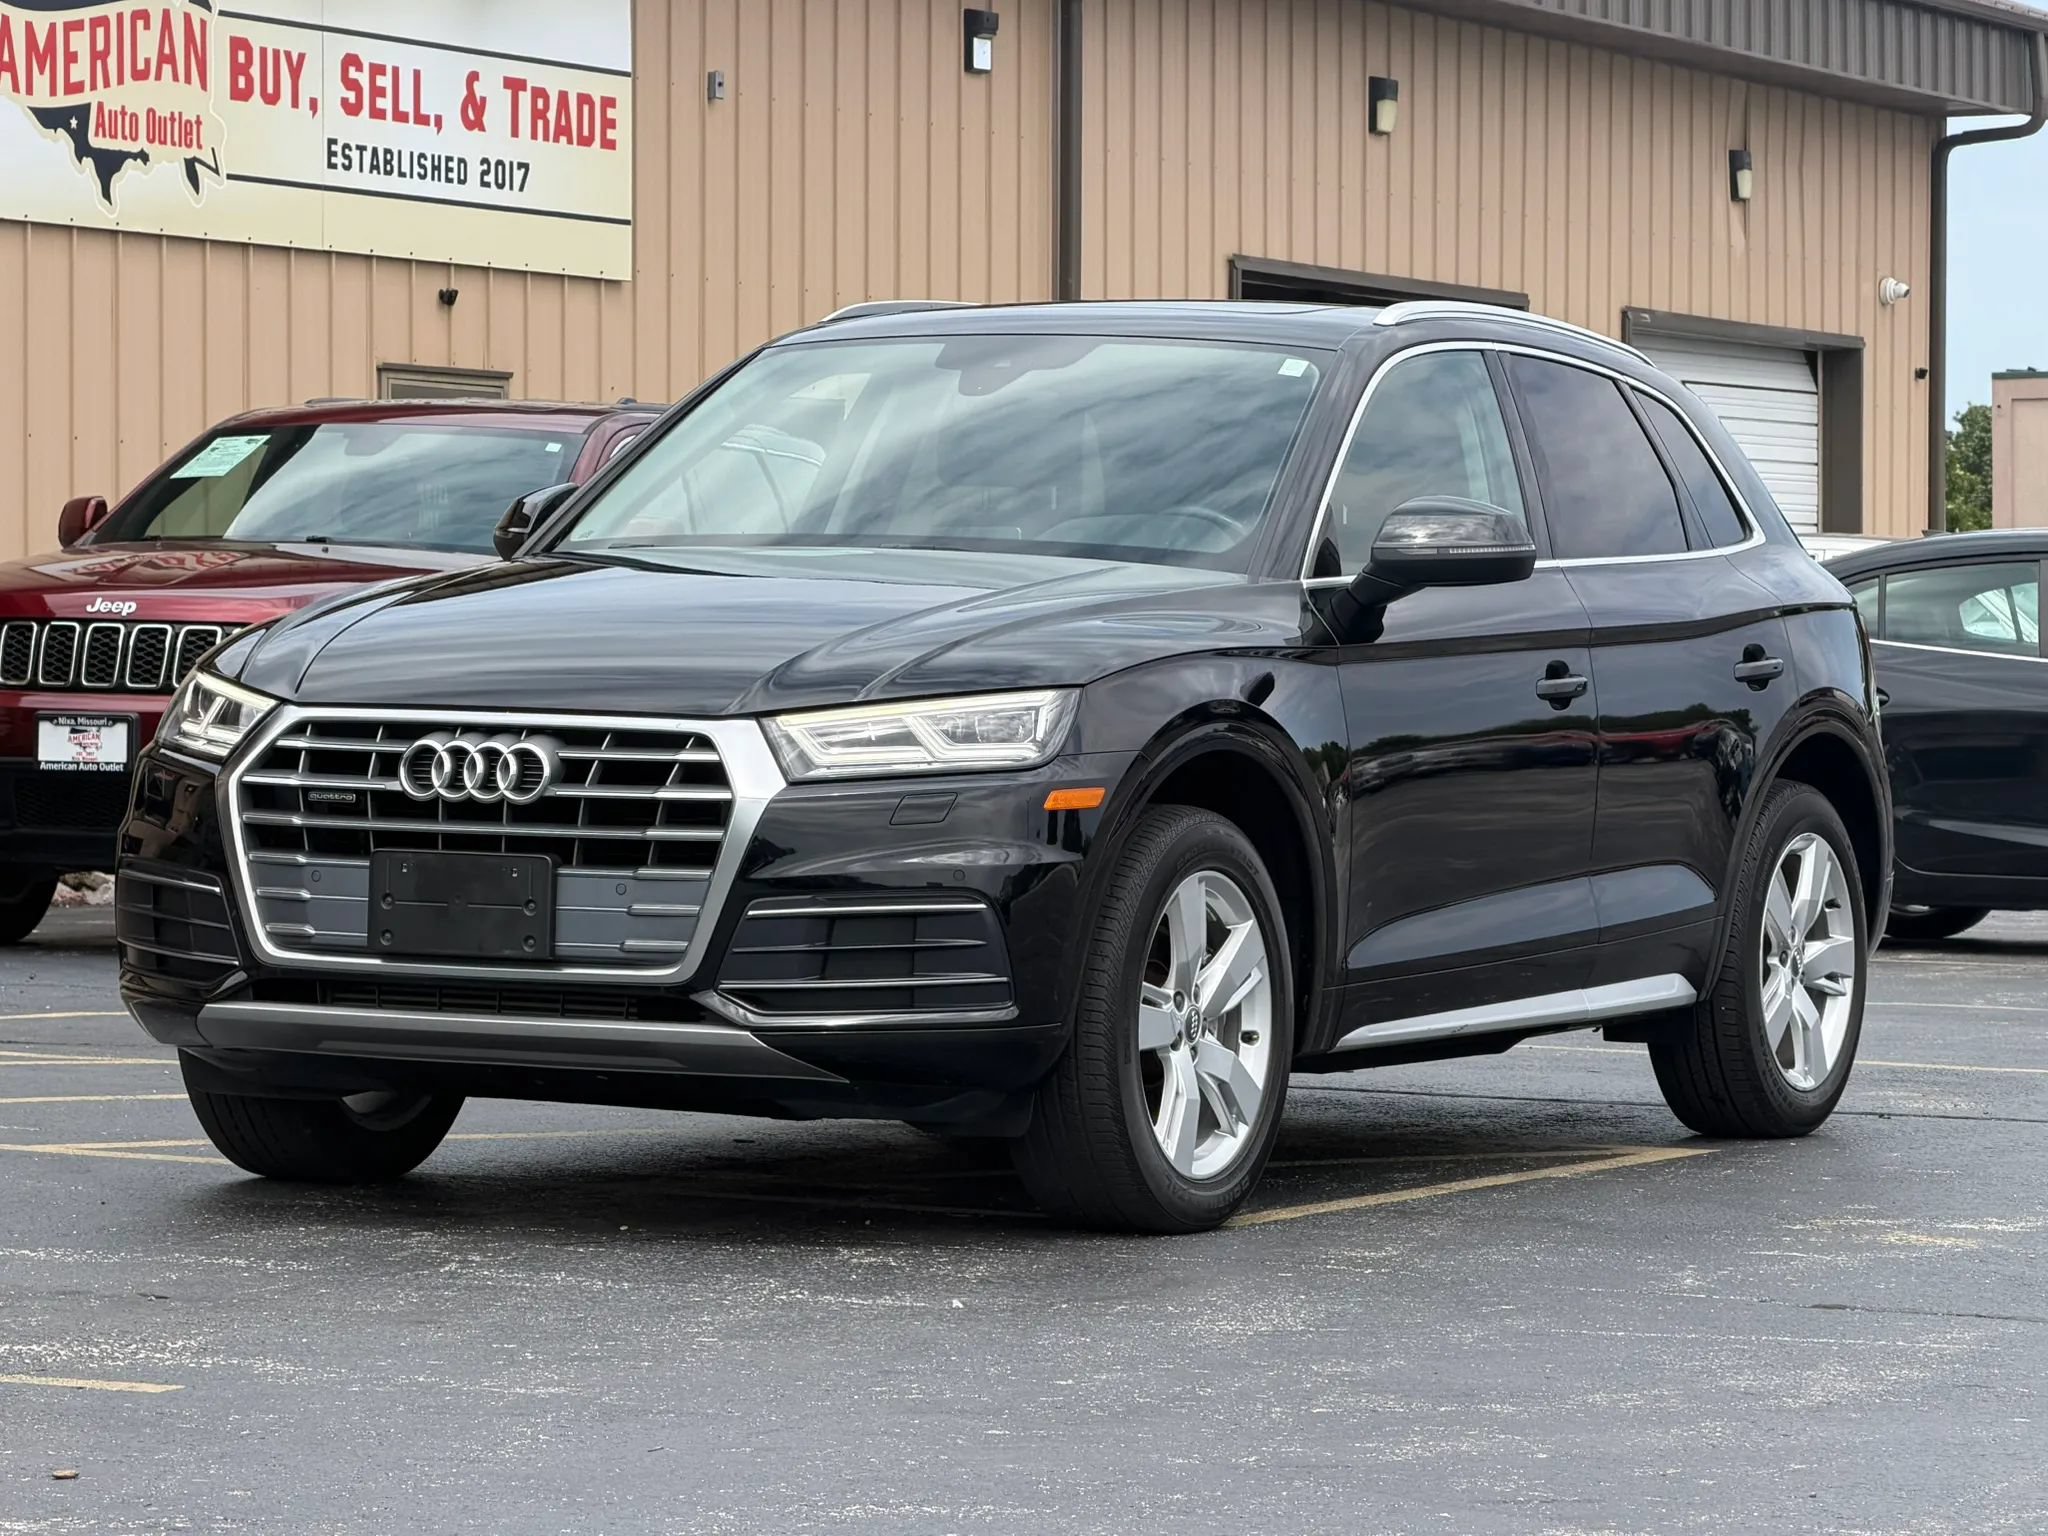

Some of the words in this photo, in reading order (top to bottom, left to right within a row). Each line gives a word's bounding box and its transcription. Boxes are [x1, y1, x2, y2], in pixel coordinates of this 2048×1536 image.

[0, 8, 208, 97] AMERICAN
[229, 35, 318, 119] BUY,
[340, 52, 443, 135] SELL,
[460, 70, 488, 132] &
[503, 76, 617, 151] TRADE
[94, 100, 139, 142] Auto
[146, 107, 203, 150] Outlet
[327, 137, 468, 186] ESTABLISHED
[479, 157, 530, 192] 2017
[86, 597, 137, 617] Jeep
[77, 716, 107, 726] Missouri
[40, 761, 77, 771] American
[79, 761, 98, 771] Auto
[99, 762, 124, 772] Outlet
[309, 792, 353, 801] quattro
